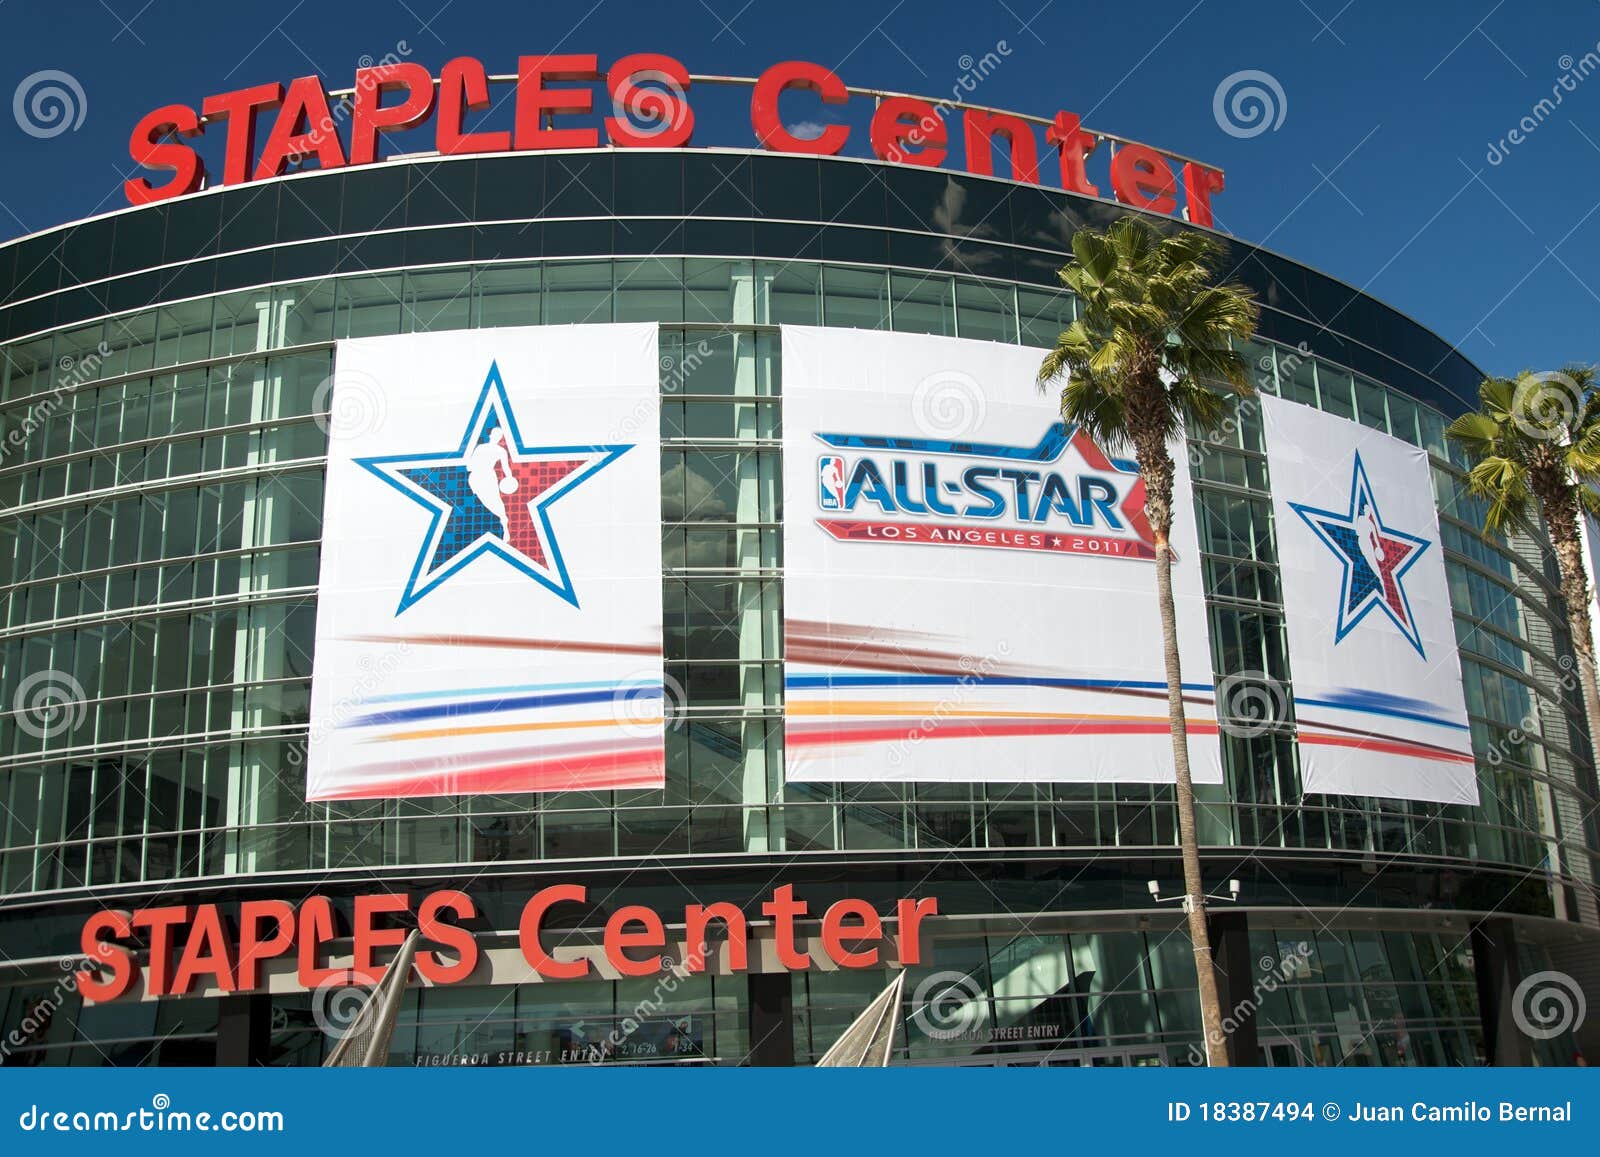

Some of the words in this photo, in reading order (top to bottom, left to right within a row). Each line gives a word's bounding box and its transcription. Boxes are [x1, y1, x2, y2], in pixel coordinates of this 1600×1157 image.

[124, 53, 695, 205] STAPLES
[751, 60, 1224, 228] Center
[845, 458, 1124, 531] ALL-STAR
[868, 525, 917, 538] LOS
[930, 528, 1041, 546] ANGELES
[1073, 538, 1120, 552] 2011
[77, 890, 479, 1002] STAPLES
[519, 883, 937, 978] Center
[416, 1054, 490, 1067] FIGUEROA
[498, 1051, 551, 1064] STREET
[561, 1047, 608, 1062] ENTRY
[988, 1026, 1024, 1040] STREET
[1027, 1024, 1060, 1038] ENTRY
